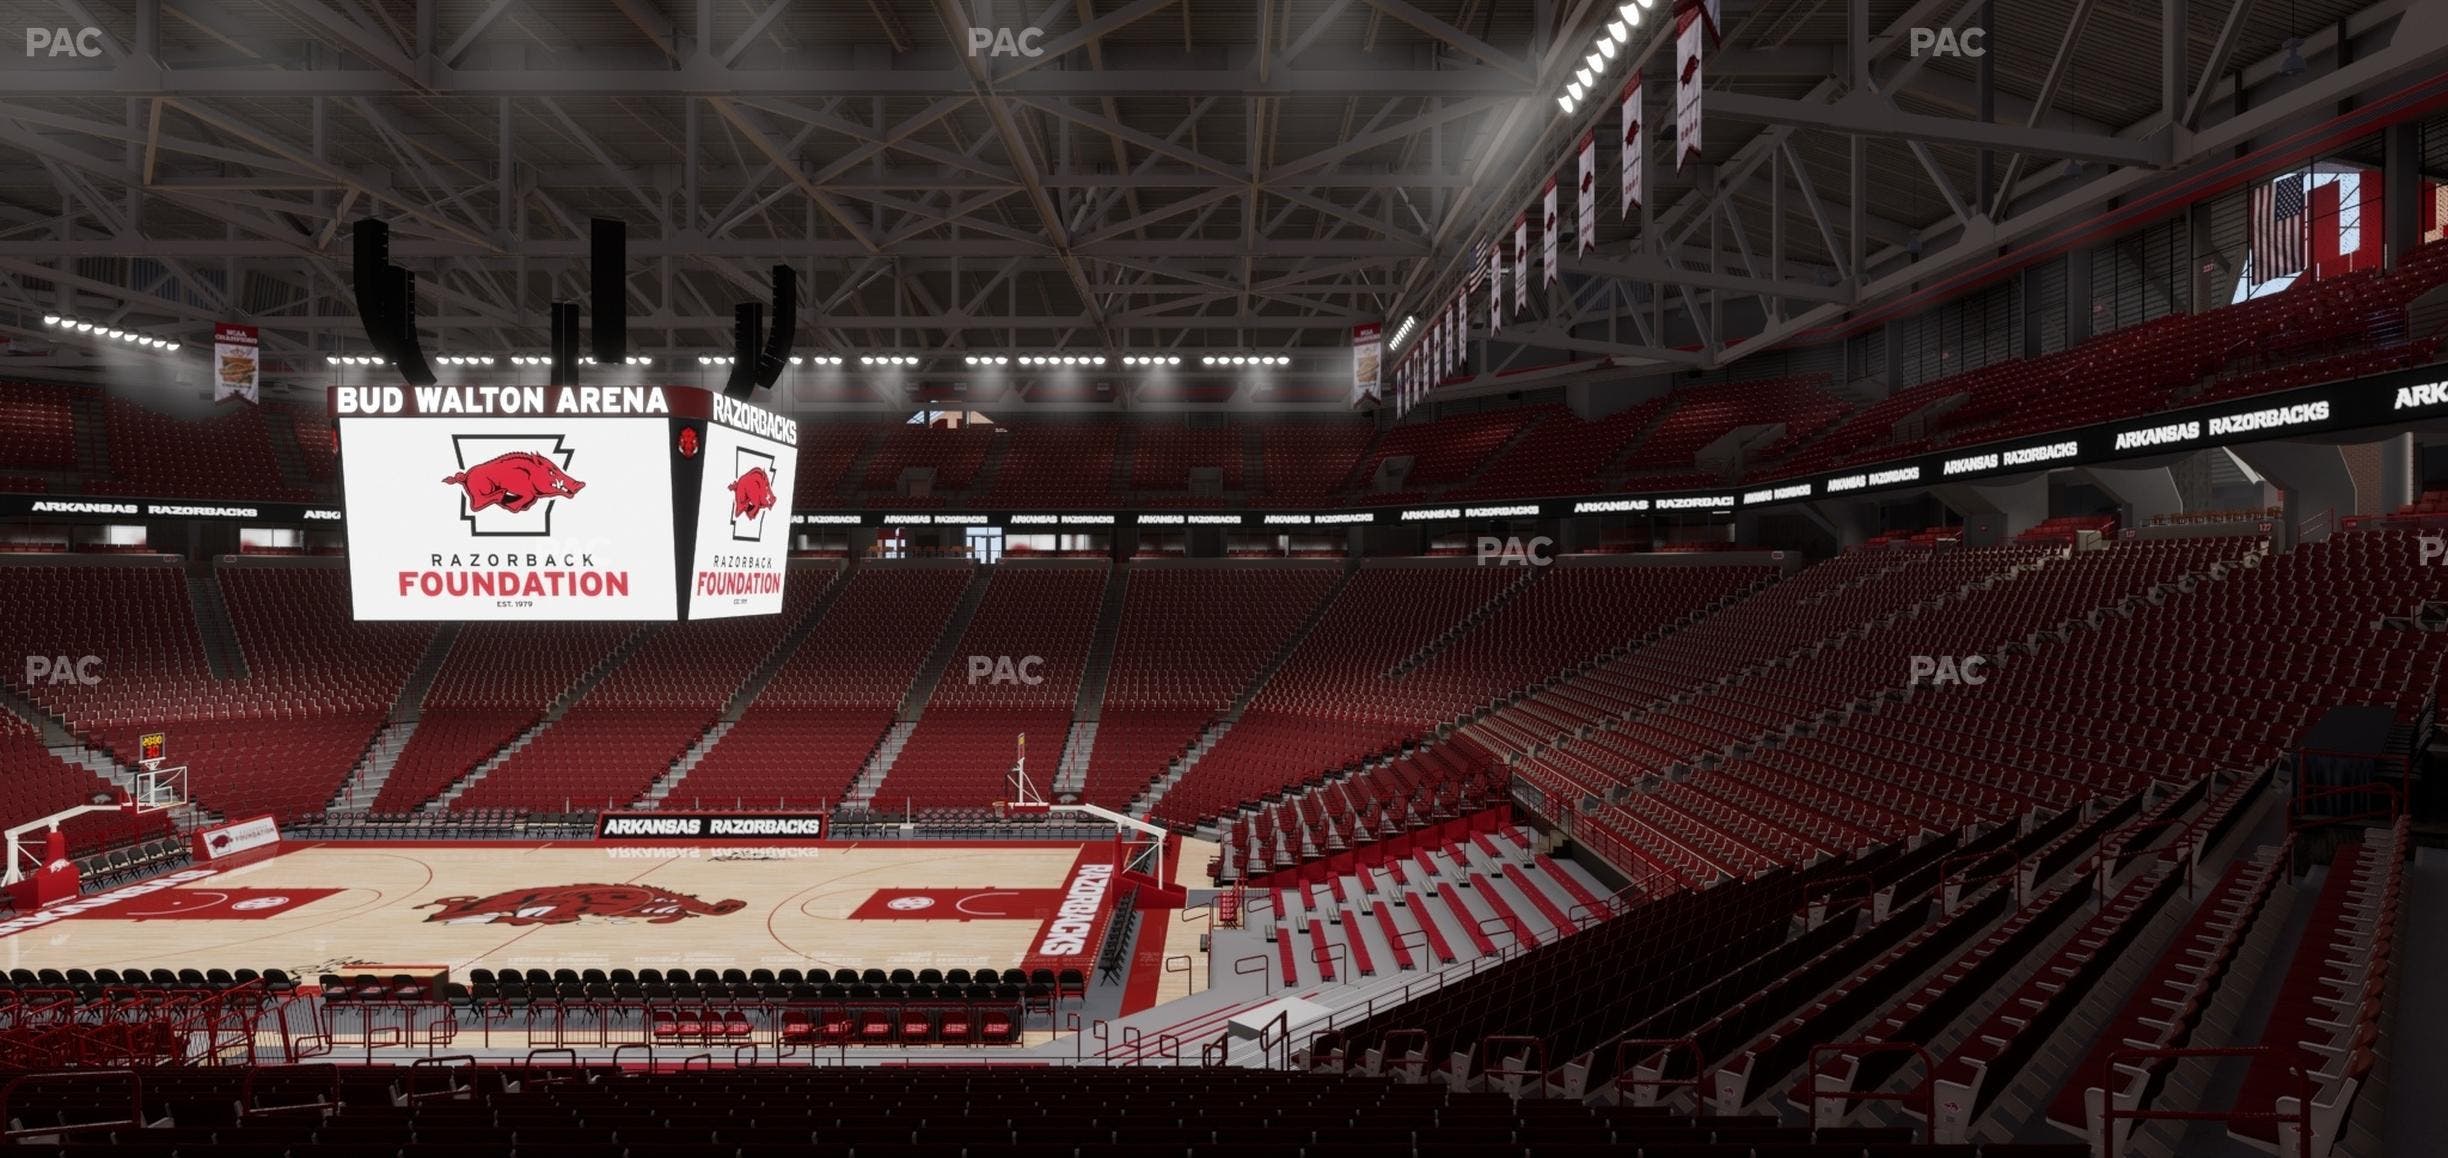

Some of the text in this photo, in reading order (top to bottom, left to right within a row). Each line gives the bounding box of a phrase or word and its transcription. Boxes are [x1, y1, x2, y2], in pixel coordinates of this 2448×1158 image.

[337, 387, 669, 413] BUD WALTON ARENA
[713, 392, 797, 446] RAZORBACKS
[2115, 401, 2329, 450] ARKANSAS RAZORBACKS
[1943, 442, 2078, 475] ARKANSAS RAZORBACKS
[1827, 467, 1920, 492] ARKANSAS RAZORBACKS
[32, 502, 257, 517] ARKANSAS RAZORBACKS
[1401, 506, 1540, 520] ARKANSAS RAZORBACKS
[1574, 500, 1650, 513] ARKANSAS
[807, 515, 861, 523] RAZORBACKS
[884, 515, 988, 523] ARKANSAS RAZORBACKS
[1011, 515, 1115, 523] ARKANSAS RAZORBACKS
[1137, 515, 1241, 523] ARKANSAS RAZORBACKS
[1264, 513, 1374, 523] ARKANSAS RAZORBACKS
[431, 553, 594, 567] RAZORBACK
[713, 554, 772, 569] RAZORBACK
[399, 571, 629, 597] FOUNDATION
[697, 571, 782, 597] FOUNDATION
[604, 819, 820, 835] ARKANSAS RAZORBACKS
[1040, 864, 1114, 956] RAZORBACKS
